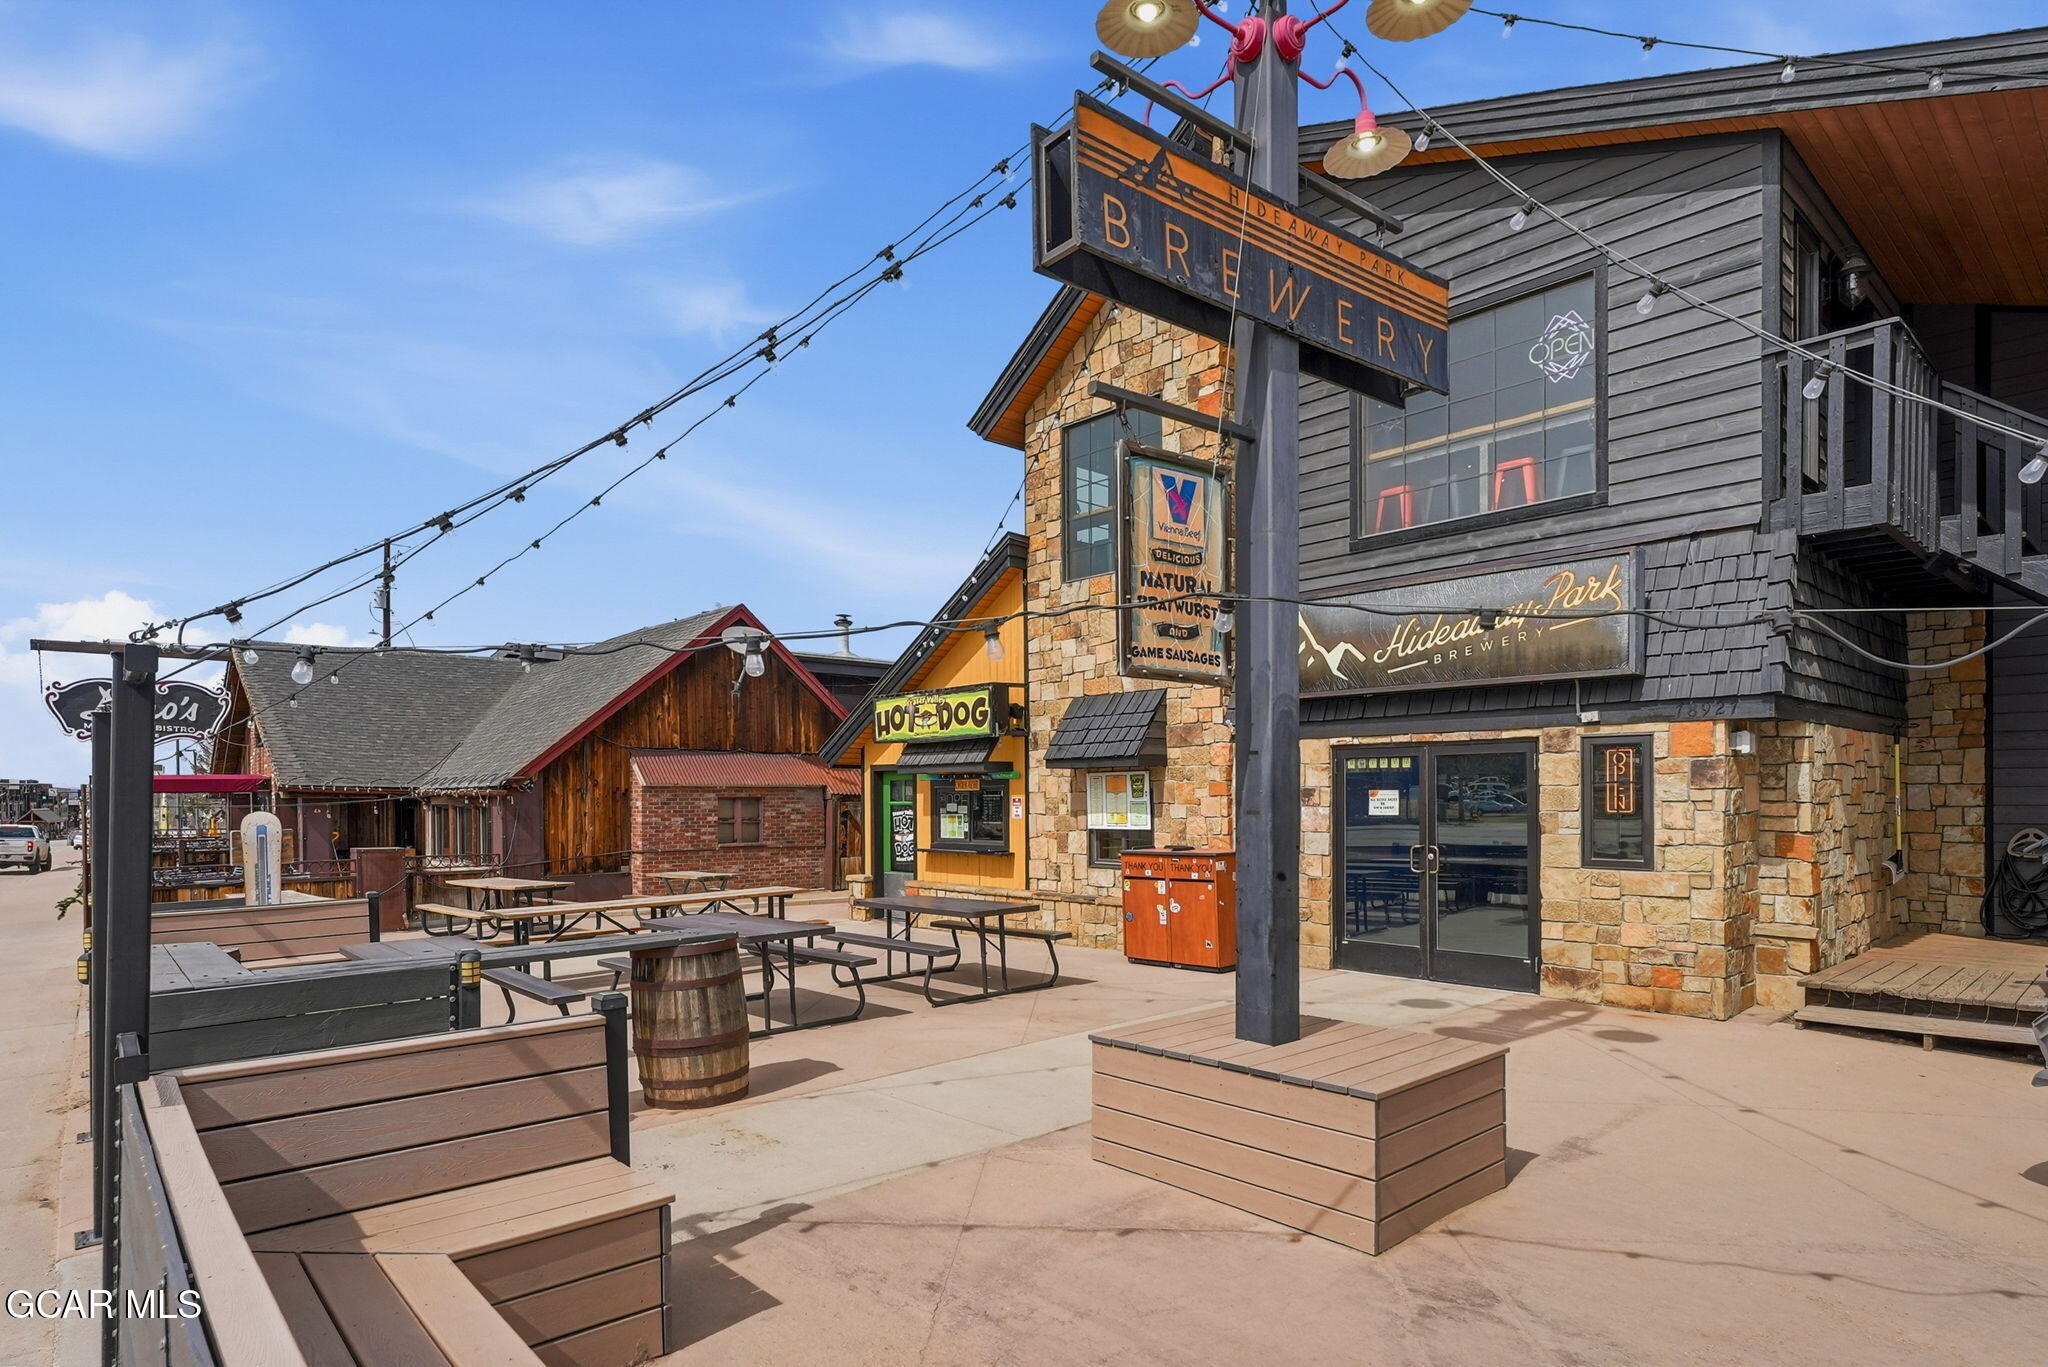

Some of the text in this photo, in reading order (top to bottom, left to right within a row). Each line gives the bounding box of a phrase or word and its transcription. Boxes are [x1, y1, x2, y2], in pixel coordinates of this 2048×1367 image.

[1228, 187, 1406, 286] HIDEAWAY PARK
[1102, 192, 1435, 375] BREWERY
[1529, 328, 1595, 364] OPEN
[1156, 549, 1201, 564] DELICIOUS
[1140, 570, 1213, 594] NATURAL
[1543, 564, 1622, 614] Park
[1169, 627, 1188, 638] AND
[1433, 628, 1543, 664] BREWERY
[1132, 645, 1221, 667] GAME SAUSAGES
[876, 697, 989, 739] HOT DOG
[1125, 862, 1163, 871] THANK YOU
[1171, 864, 1213, 873] THANK YOU
